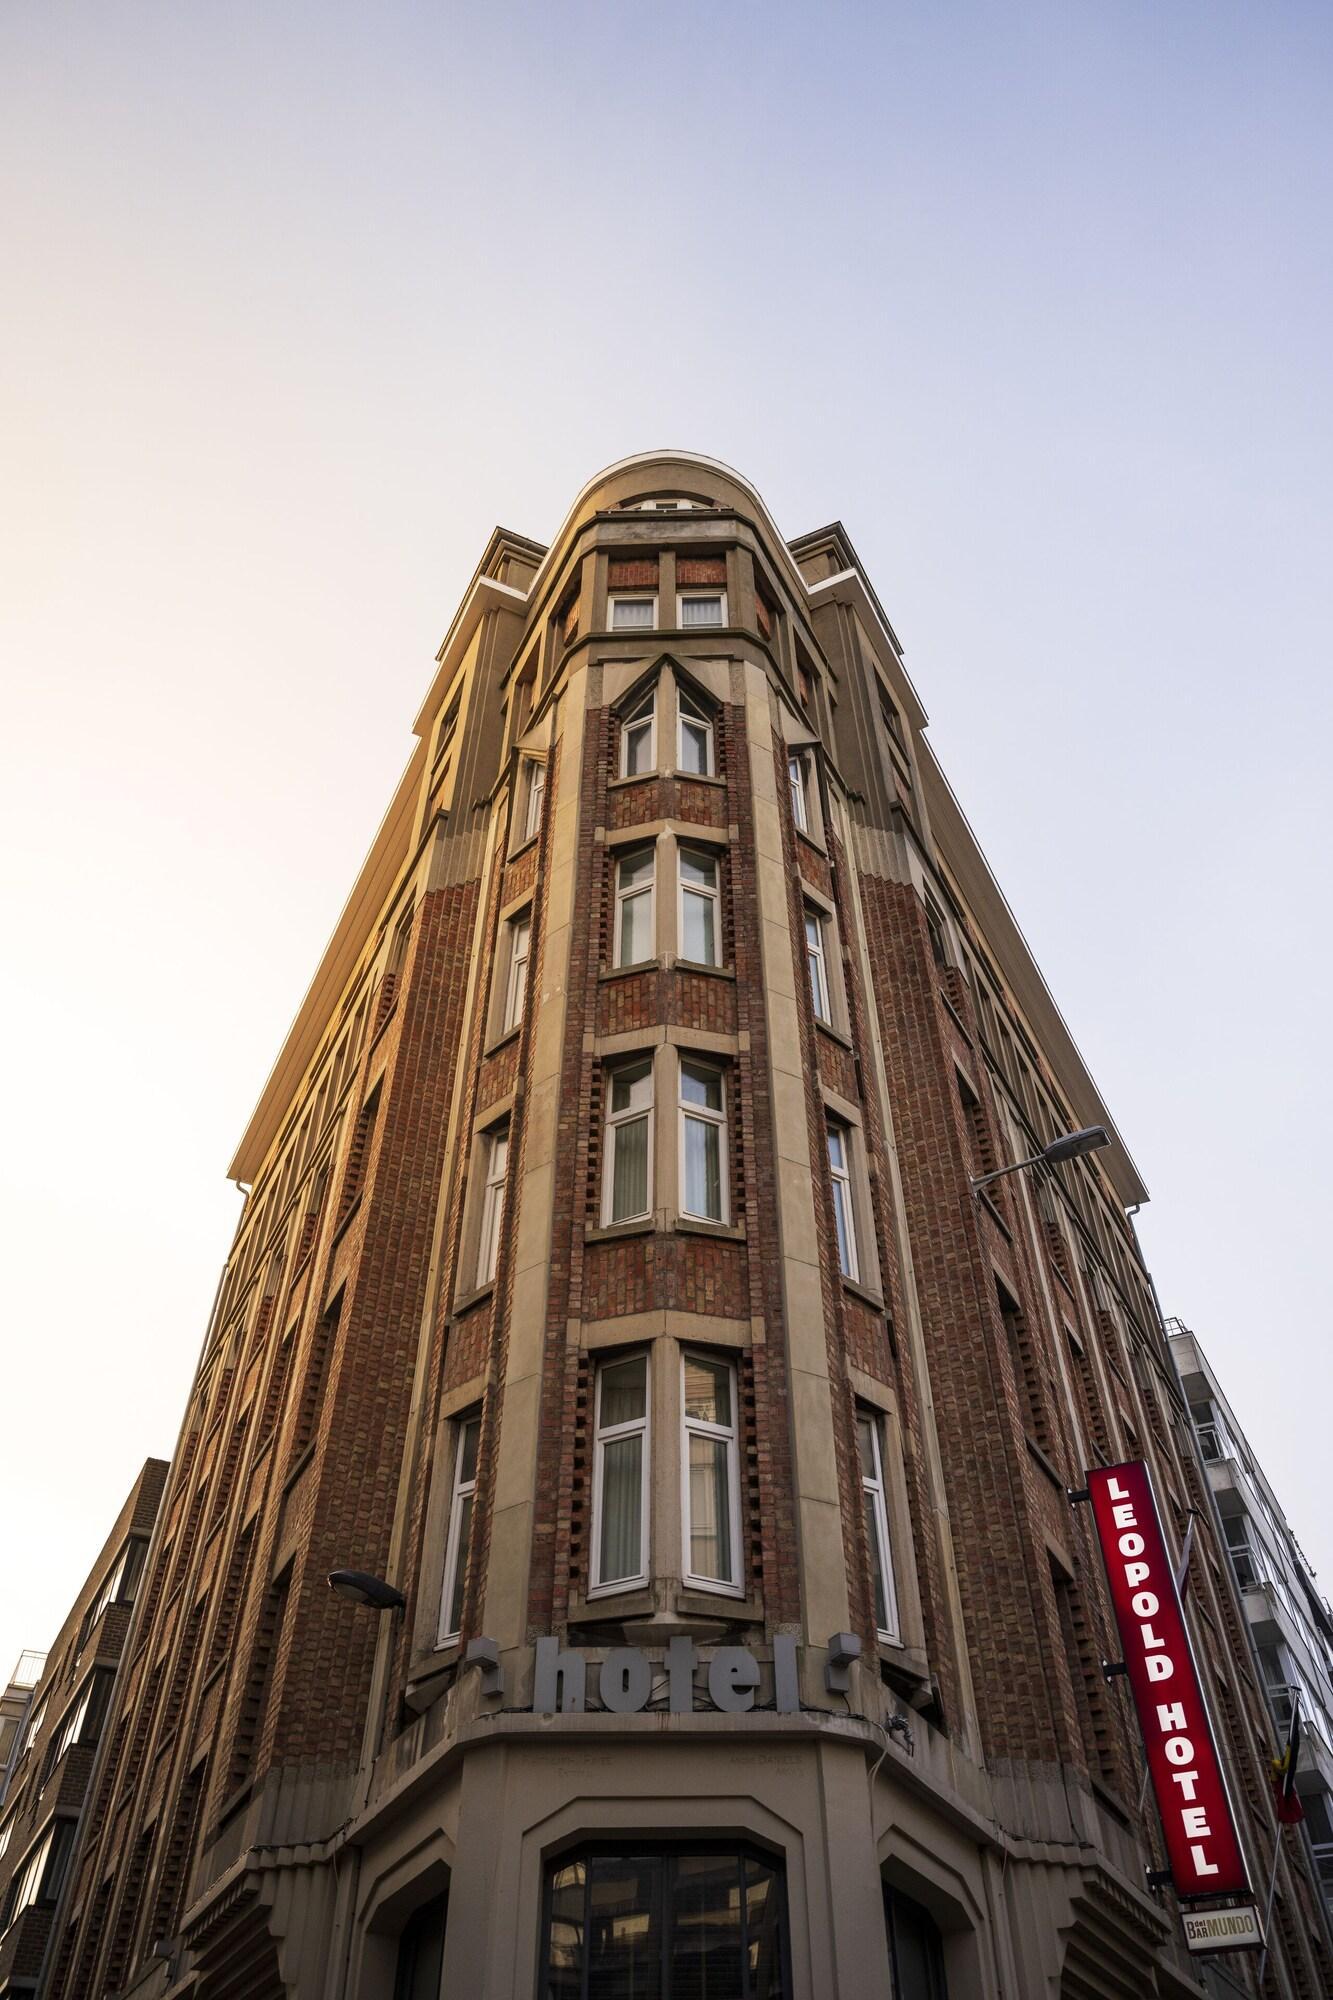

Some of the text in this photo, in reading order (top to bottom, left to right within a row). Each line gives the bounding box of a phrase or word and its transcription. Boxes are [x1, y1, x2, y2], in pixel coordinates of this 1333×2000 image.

[533, 1634, 800, 1713] hotel
[1107, 1478, 1219, 1876] LEOPOLD HOTEL
[1207, 1915, 1254, 1937] MUNDO
